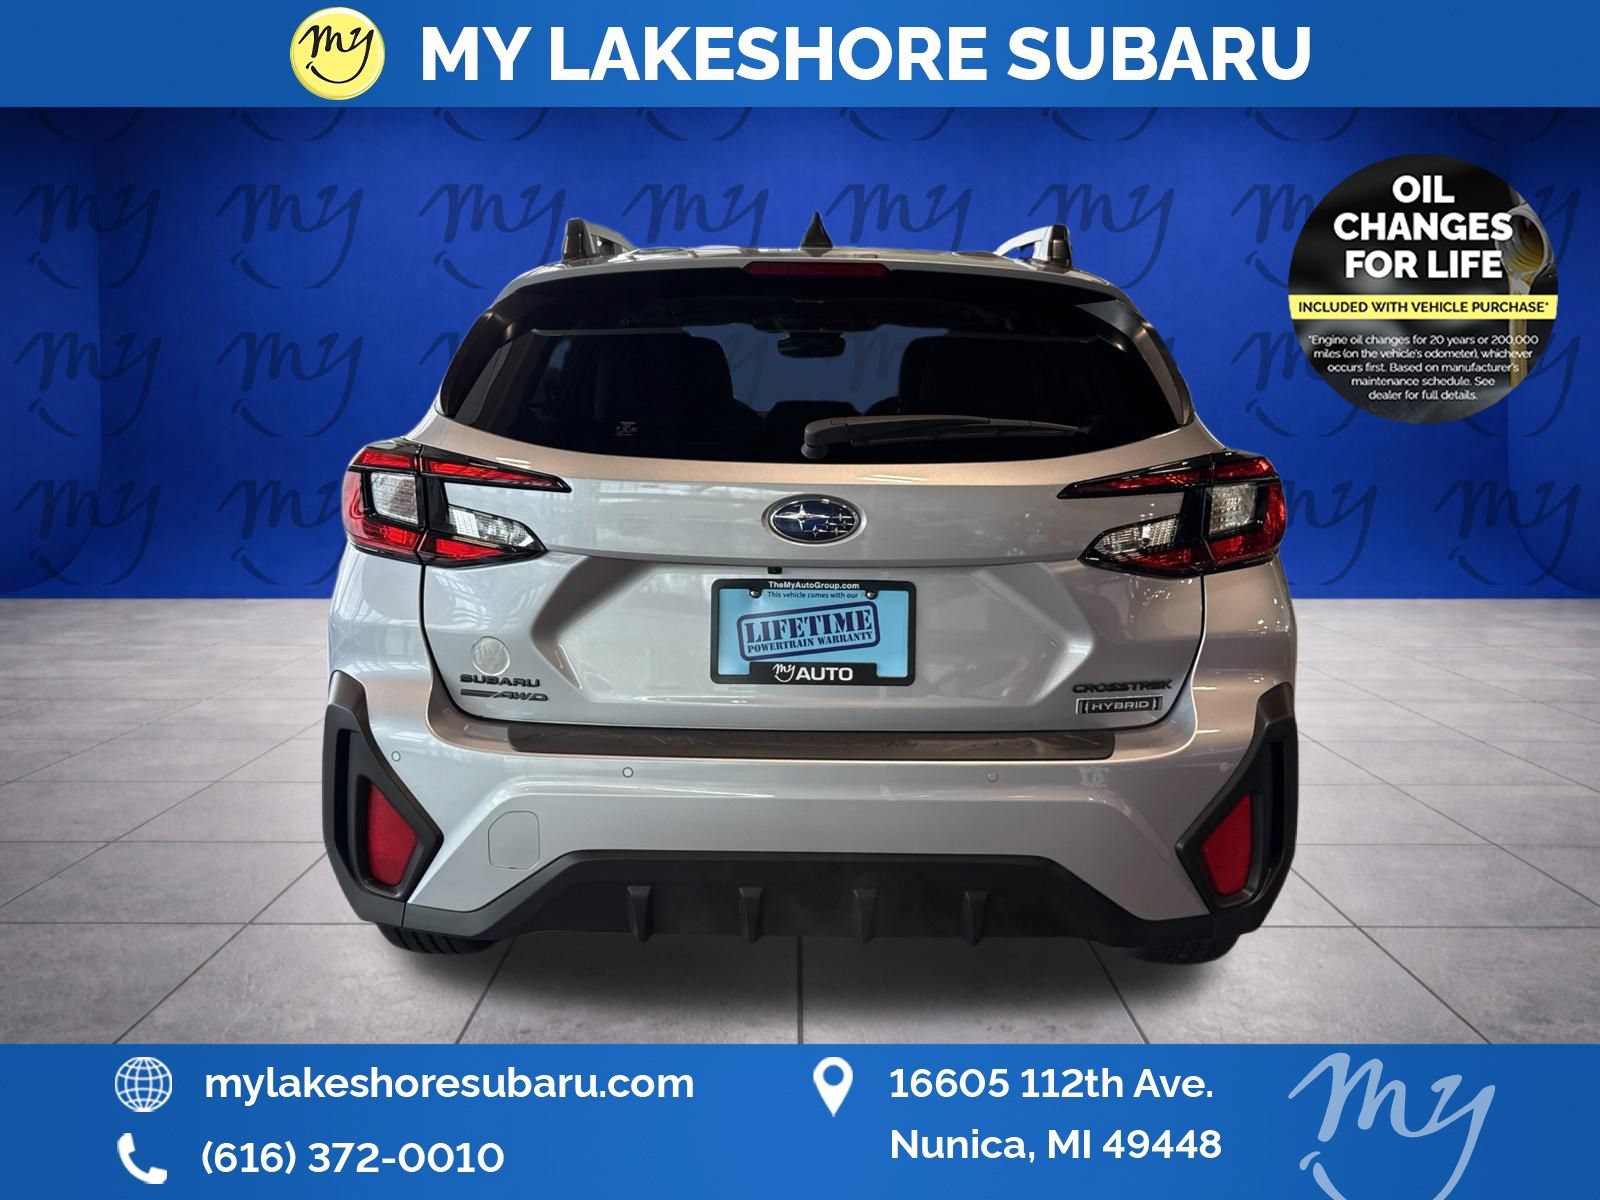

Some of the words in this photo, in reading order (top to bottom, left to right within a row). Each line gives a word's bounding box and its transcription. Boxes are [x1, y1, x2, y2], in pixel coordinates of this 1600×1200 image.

[767, 581, 860, 590] TheMyAutoGroup.com
[744, 609, 873, 643] LIFETIME
[747, 638, 815, 653] POWERTRAIN
[817, 631, 873, 646] WARRANTY
[460, 674, 540, 687] SUBARU
[795, 667, 853, 681] AUTO
[1072, 680, 1172, 693] CROSSTREK
[493, 691, 549, 702] AWD
[1091, 701, 1149, 711] HYBRID
